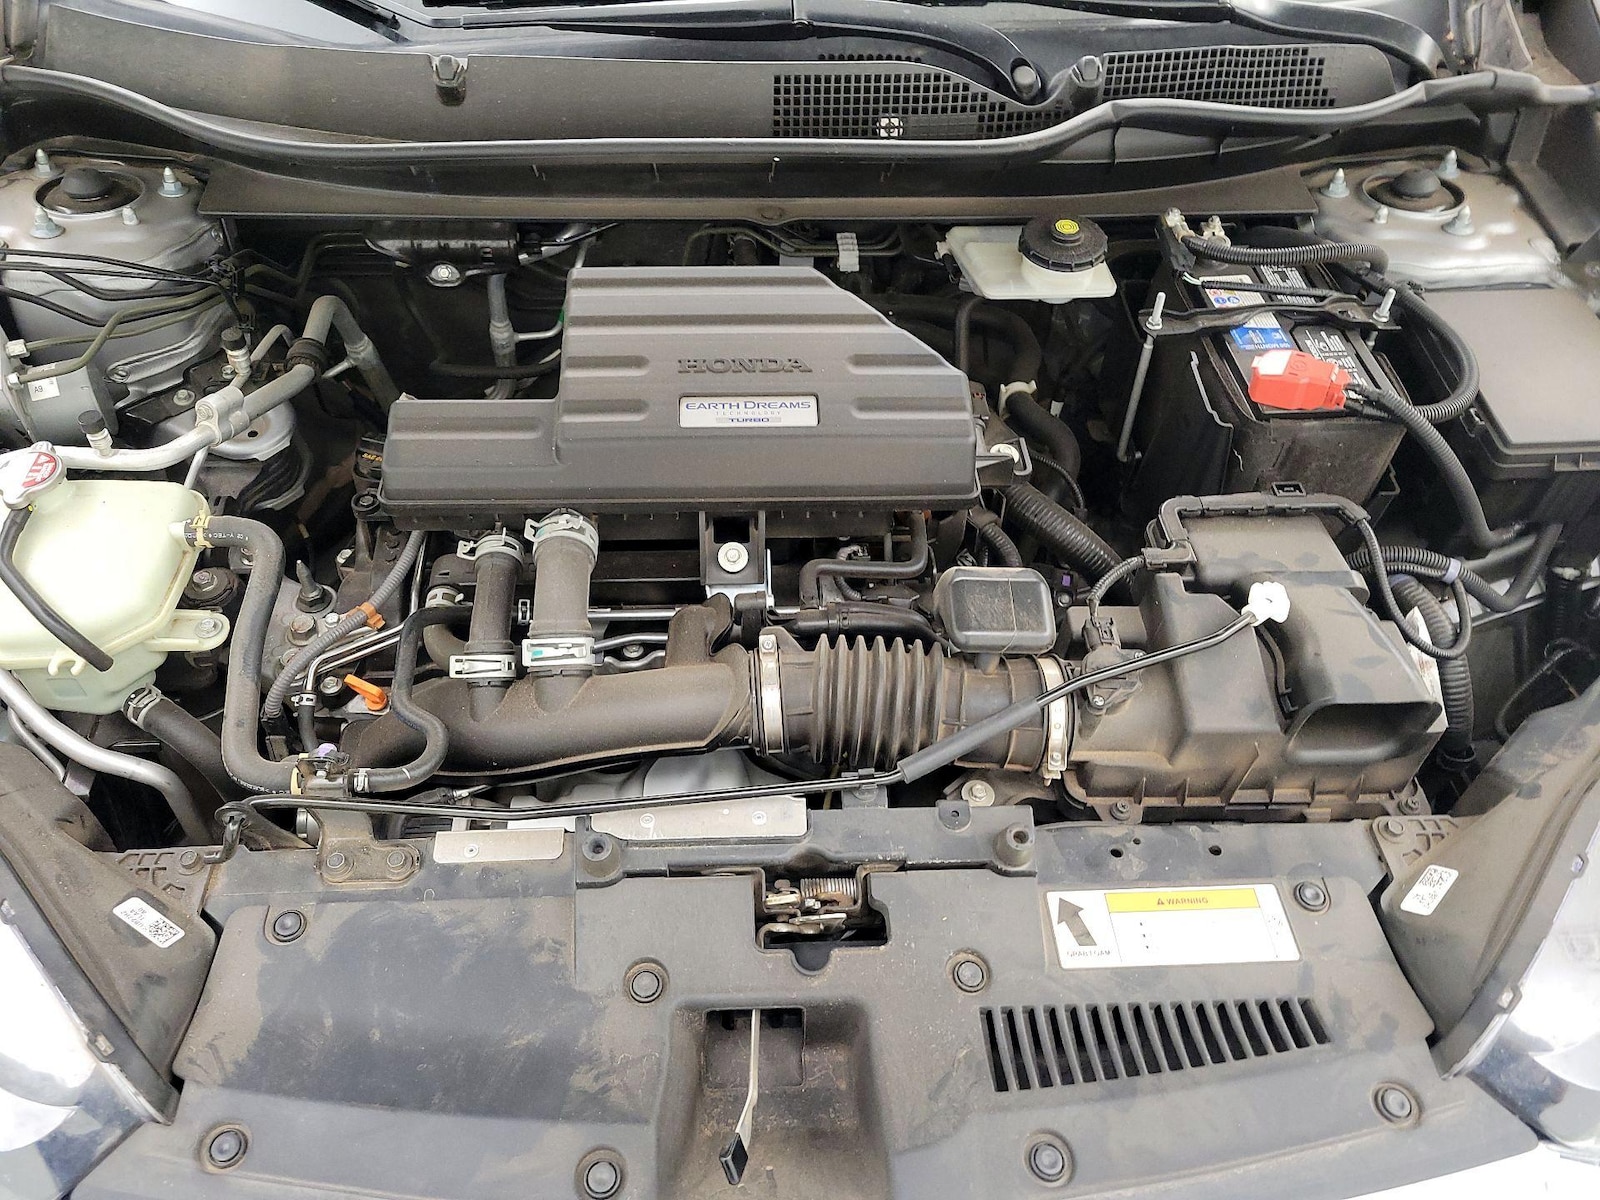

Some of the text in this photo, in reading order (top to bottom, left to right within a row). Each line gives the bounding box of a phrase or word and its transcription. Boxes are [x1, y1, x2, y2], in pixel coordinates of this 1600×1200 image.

[678, 358, 813, 374] HONDA
[685, 401, 811, 410] EARTH DREAMS
[1166, 896, 1209, 905] WARNING
